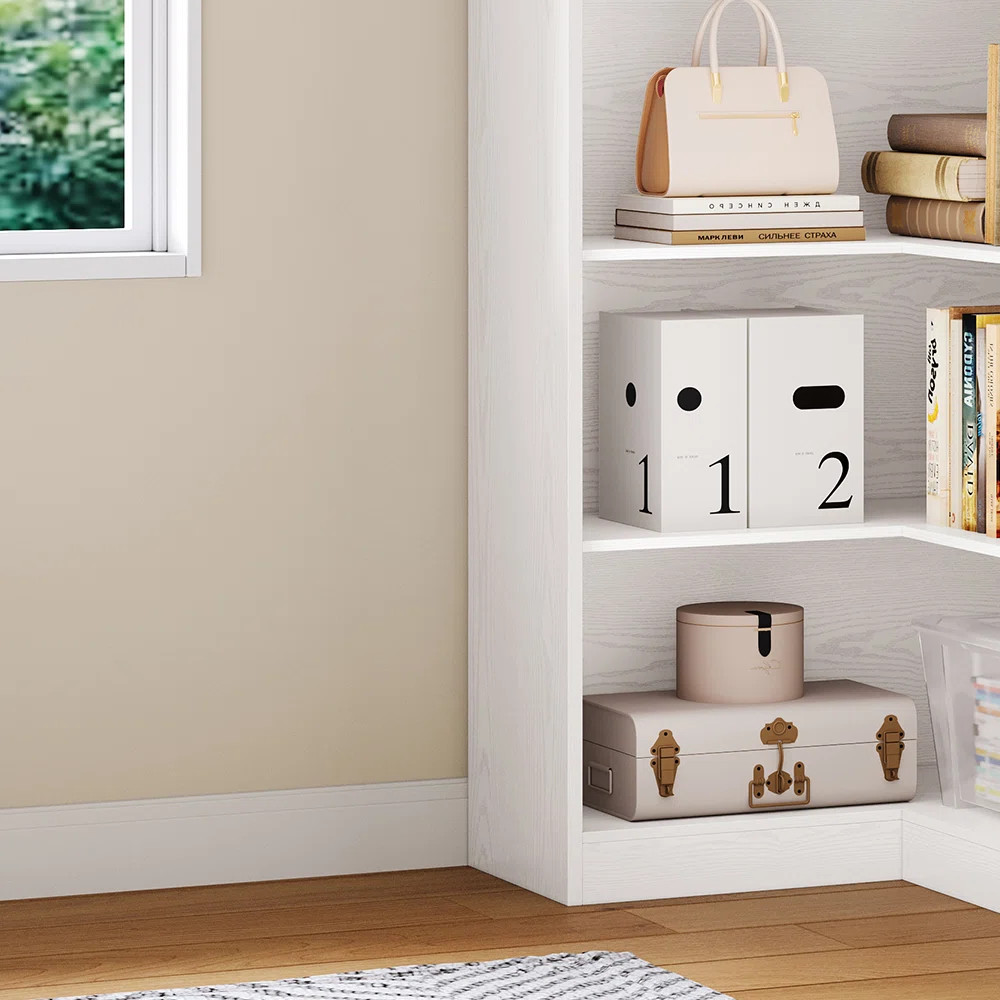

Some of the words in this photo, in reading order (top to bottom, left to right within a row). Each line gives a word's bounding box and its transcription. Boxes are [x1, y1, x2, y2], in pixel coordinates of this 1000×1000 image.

[804, 231, 837, 239] СТРАХА
[638, 454, 653, 515] 1
[708, 454, 741, 515] 1
[817, 451, 854, 510] 2
